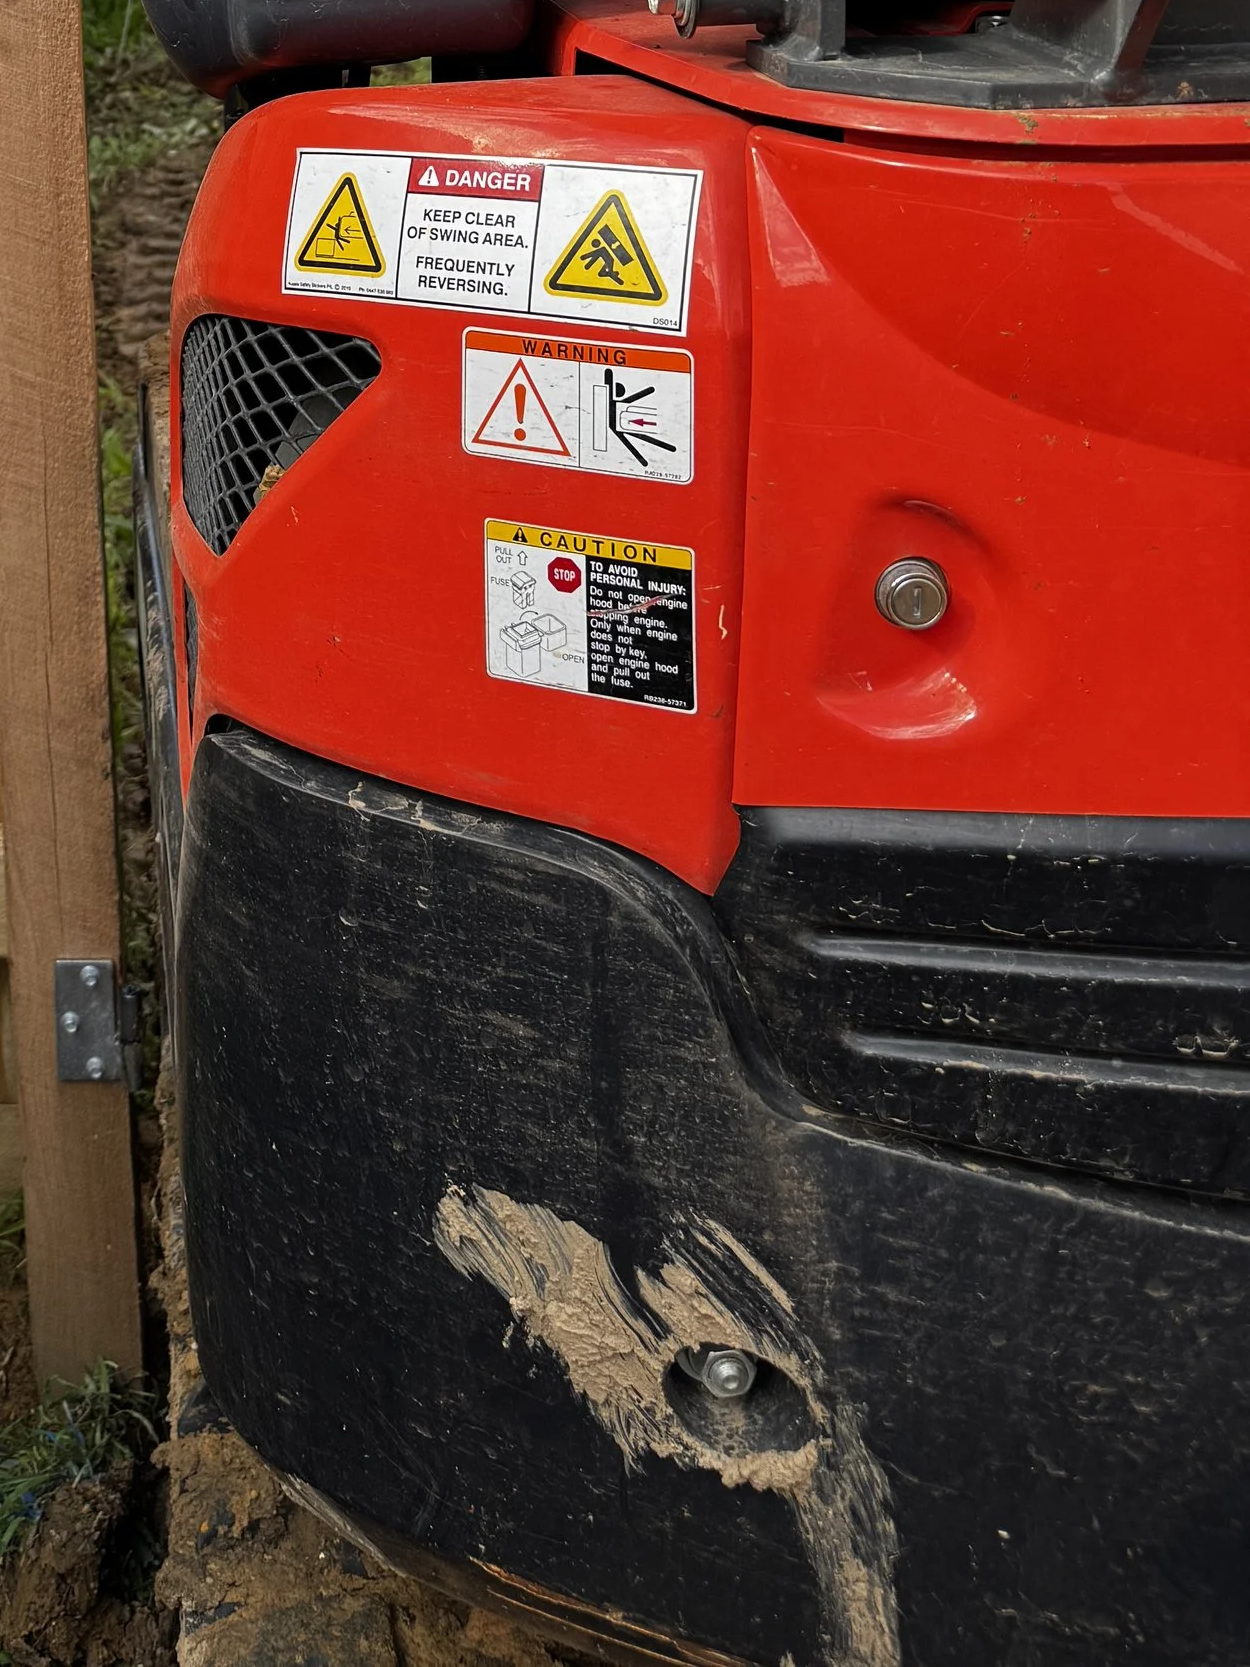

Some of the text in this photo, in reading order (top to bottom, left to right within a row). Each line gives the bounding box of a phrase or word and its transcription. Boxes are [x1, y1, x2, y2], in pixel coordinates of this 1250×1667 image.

[445, 169, 531, 191] DANGER
[423, 208, 516, 228] KEEP CLEAR
[407, 226, 528, 249] OF SWING AREA.
[416, 255, 515, 277] FREQUENTLY
[418, 275, 508, 296] REVERSING.
[652, 317, 677, 327] DS014
[522, 339, 627, 365] WARNING
[495, 545, 513, 556] PULL
[540, 531, 657, 563] CAUTION
[496, 555, 511, 564] OUT
[553, 568, 575, 581] STOP
[589, 561, 638, 577] TO AVOID
[490, 576, 510, 586] FUSE
[590, 572, 686, 595] PERSONAL INJURY:
[590, 585, 602, 596] Do
[608, 590, 622, 599] not
[590, 596, 612, 608] hood
[590, 618, 677, 641] Only when engine
[634, 616, 667, 628] engine.
[590, 630, 632, 645] does not
[590, 641, 610, 652] stop
[615, 644, 626, 656] by
[562, 653, 584, 664] OPEN
[590, 652, 678, 674] open engine hood
[591, 663, 650, 680] and pull out
[591, 673, 633, 688] the fuse.
